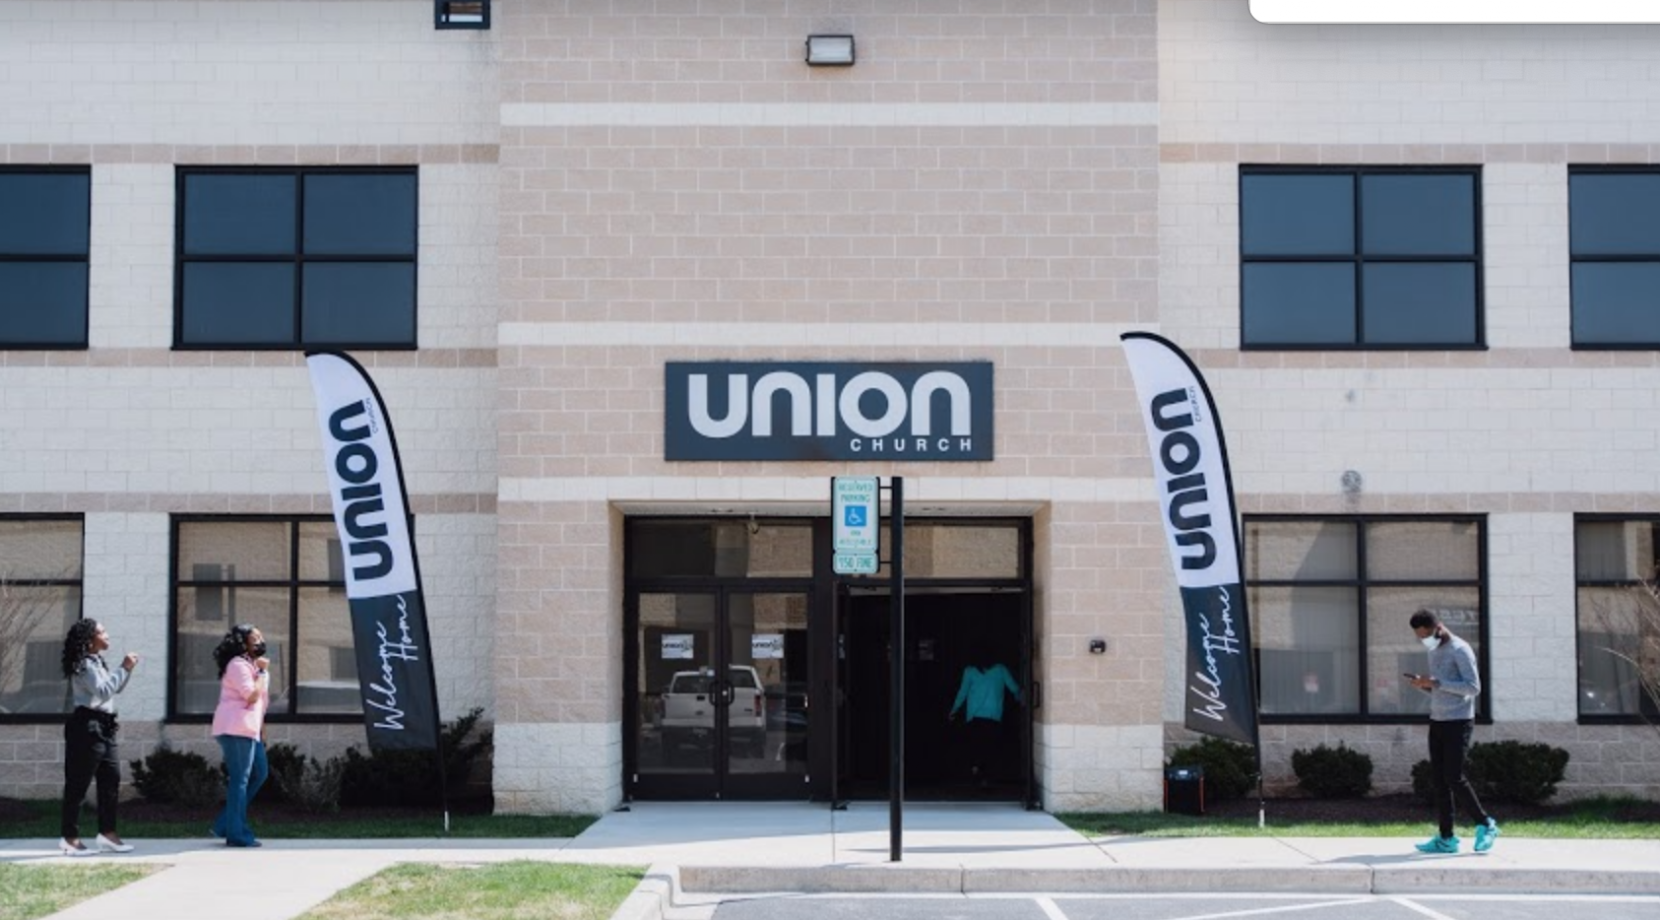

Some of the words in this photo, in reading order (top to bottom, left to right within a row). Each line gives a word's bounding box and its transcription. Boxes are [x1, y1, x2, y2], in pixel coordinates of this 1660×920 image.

[688, 371, 972, 438] UNION
[849, 439, 972, 452] CHURCH
[328, 399, 394, 581] UNION
[1151, 387, 1218, 571] UNION
[386, 594, 419, 661] Home
[1209, 585, 1240, 655] Home
[366, 620, 405, 730] Welcome
[1190, 612, 1228, 722] Welcome
